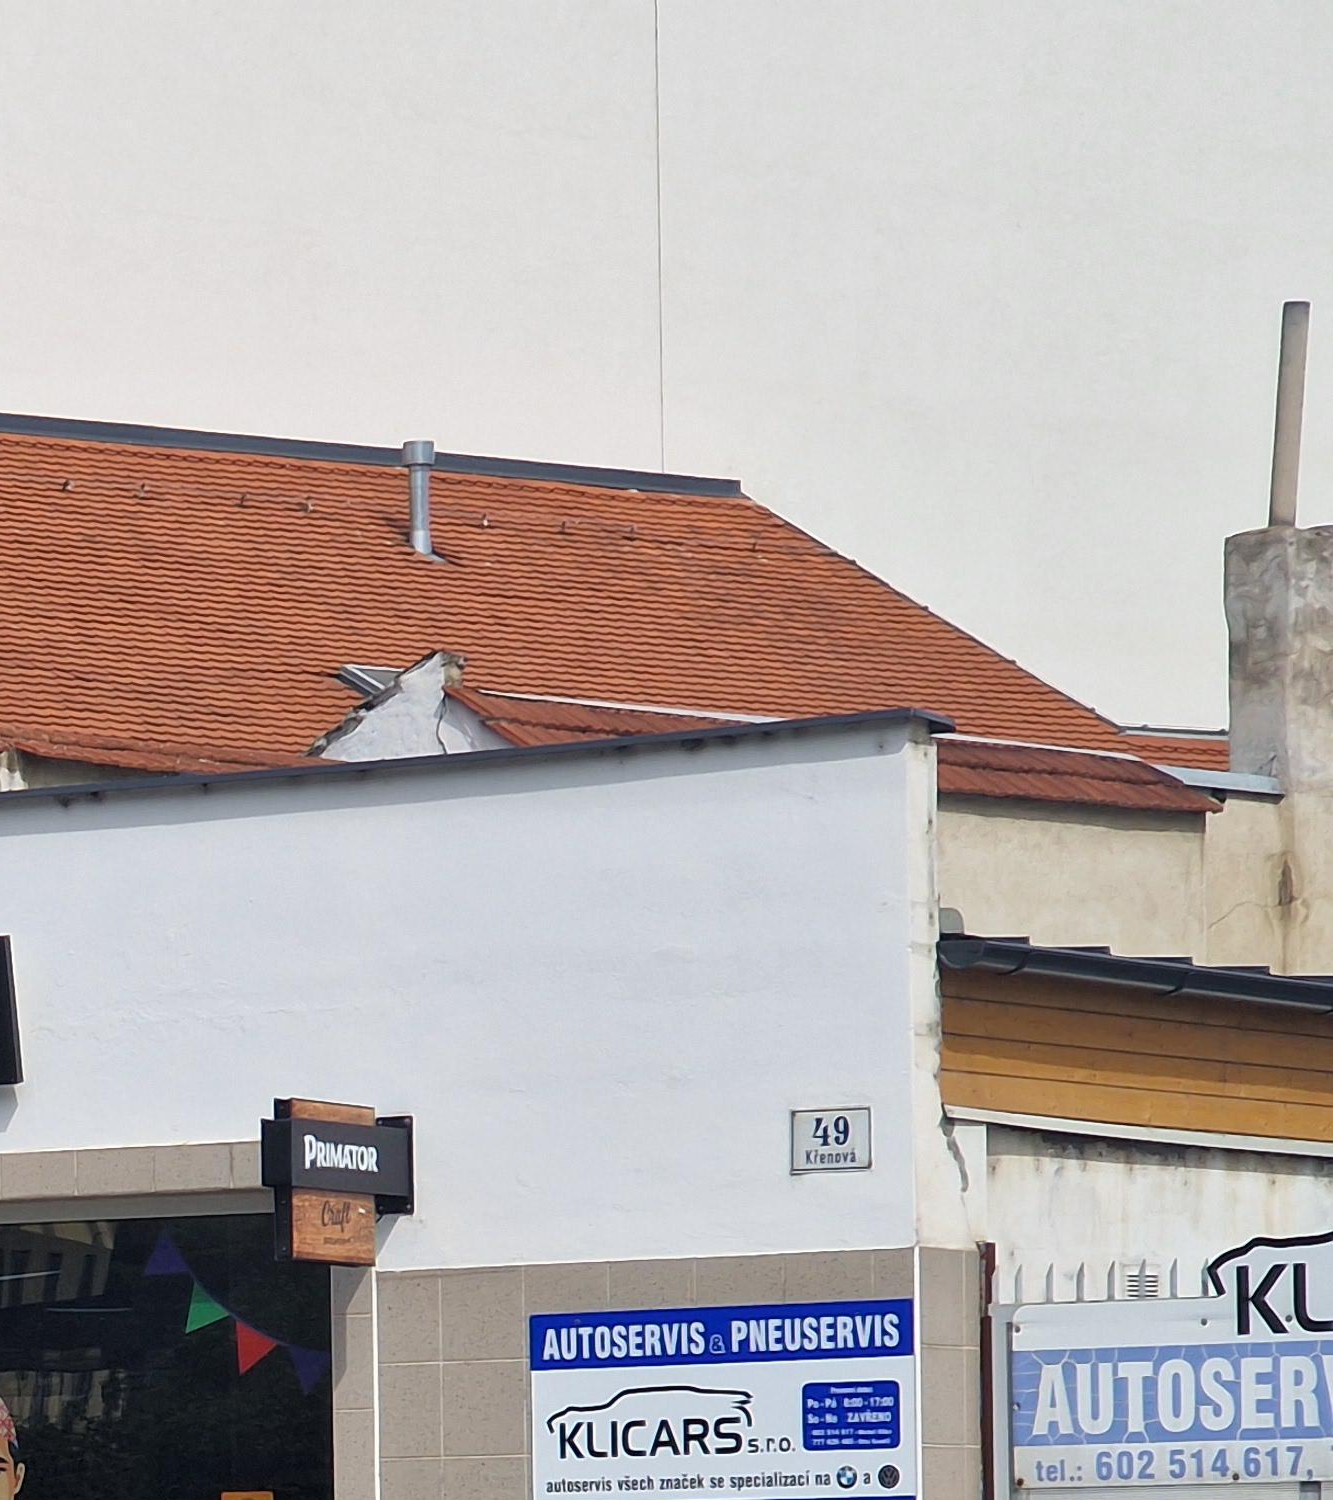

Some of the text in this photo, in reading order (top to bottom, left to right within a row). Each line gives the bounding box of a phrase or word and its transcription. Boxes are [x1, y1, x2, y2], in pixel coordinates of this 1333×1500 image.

[812, 1115, 850, 1147] 49
[303, 1134, 379, 1173] PRIMATOR
[805, 1147, 857, 1165] Křenová
[542, 1313, 901, 1361] AUTOSERVIS & PNEUSERVIS
[1033, 1354, 1333, 1436] AUTOSER
[559, 1416, 796, 1459] KLICARS s.r.o.
[546, 1477, 612, 1493] autoservis
[617, 1475, 655, 1491] všech
[659, 1474, 705, 1490] značek
[709, 1476, 725, 1489] se
[729, 1470, 810, 1491] specializací
[815, 1473, 831, 1486] na
[862, 1472, 871, 1484] a
[1036, 1459, 1083, 1482] tel.:
[1095, 1450, 1156, 1481] 602
[1168, 1448, 1229, 1479] 514
